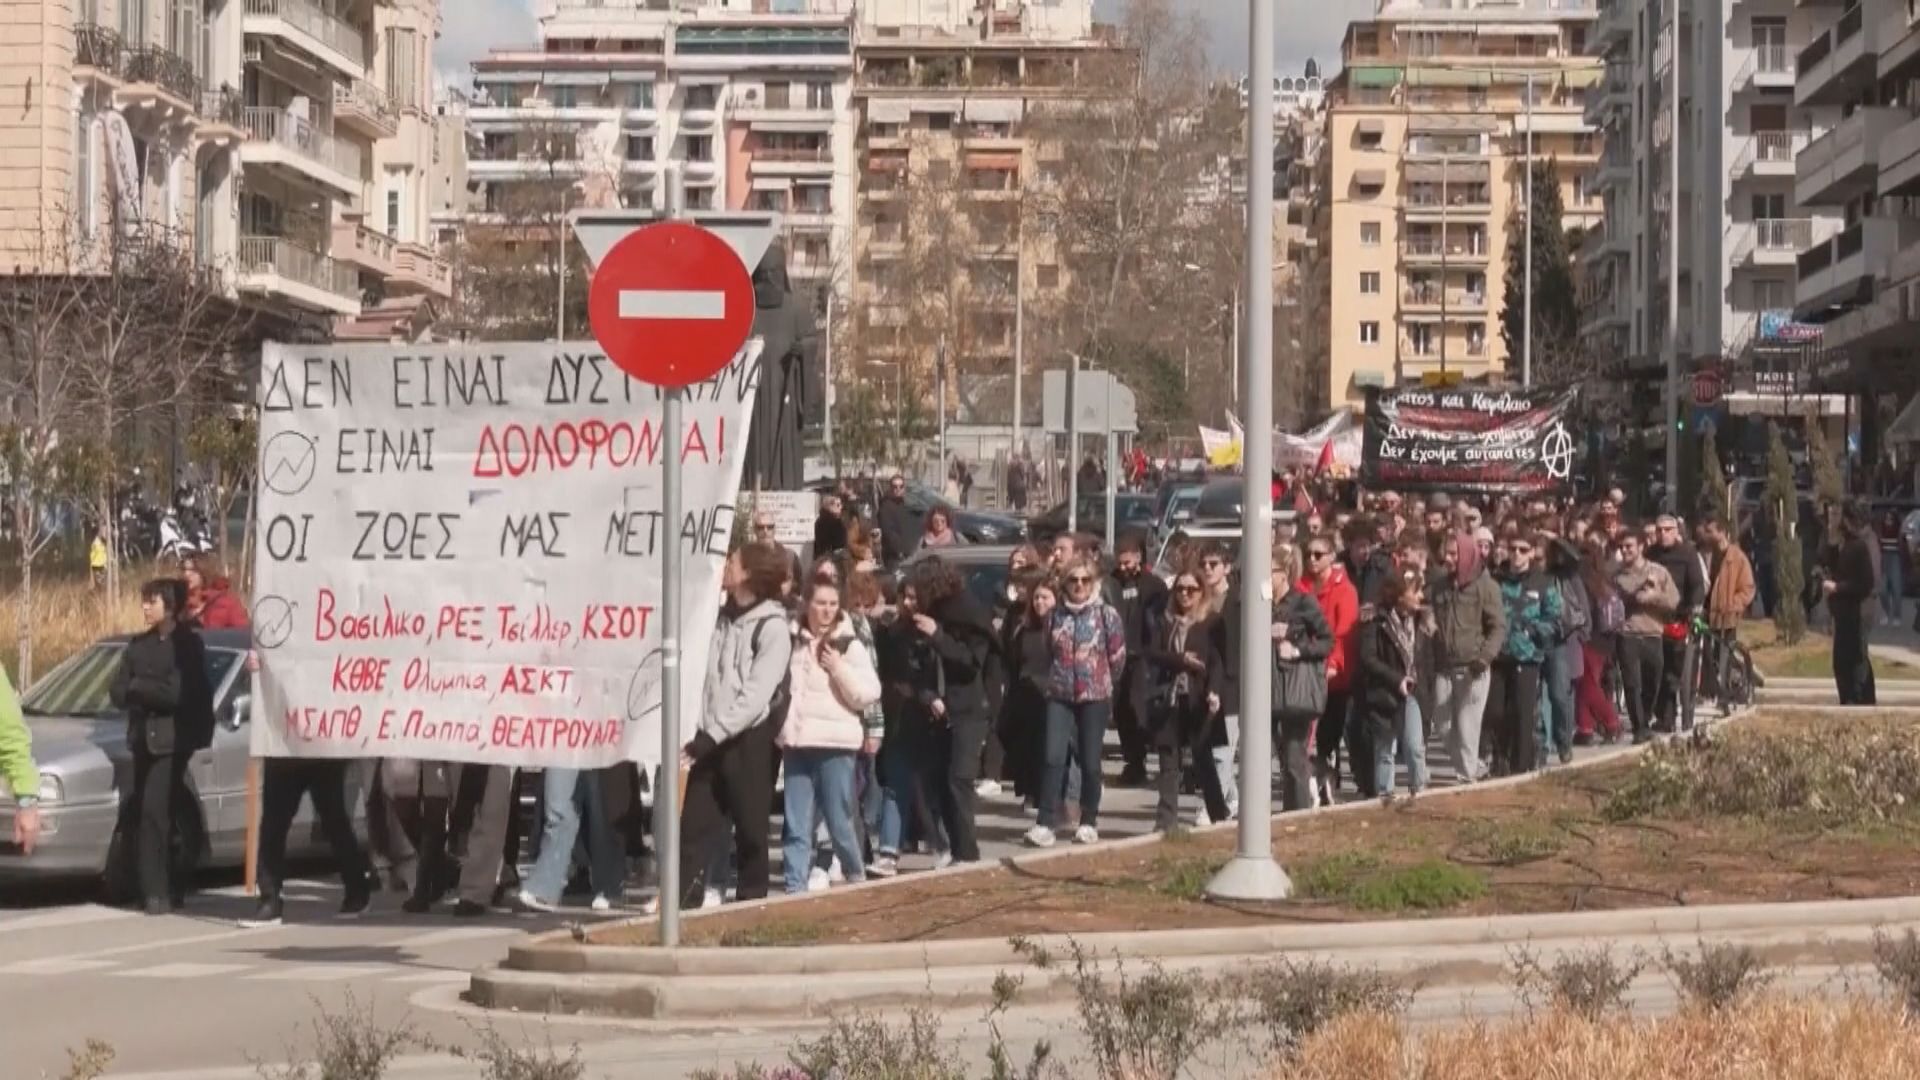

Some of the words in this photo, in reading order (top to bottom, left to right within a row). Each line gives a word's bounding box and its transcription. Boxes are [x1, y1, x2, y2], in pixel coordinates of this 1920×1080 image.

[264, 357, 353, 411] ΔΕΝ
[393, 355, 509, 409] ΕΙΝΑΙ
[336, 427, 435, 473] ΕΙΝΑΙ
[473, 415, 725, 478] ΔΟΛΟΦΟΝΑ!
[1380, 440, 1406, 457] Δεν
[1387, 423, 1415, 440] Δεν
[266, 514, 314, 562] ΟΙ
[352, 510, 461, 560] ΖΩΕΣ
[500, 511, 570, 557] ΜΑΣ
[604, 504, 735, 559] ΜΕΤΑΝΕ
[583, 604, 654, 640] ΚΣΟΤ
